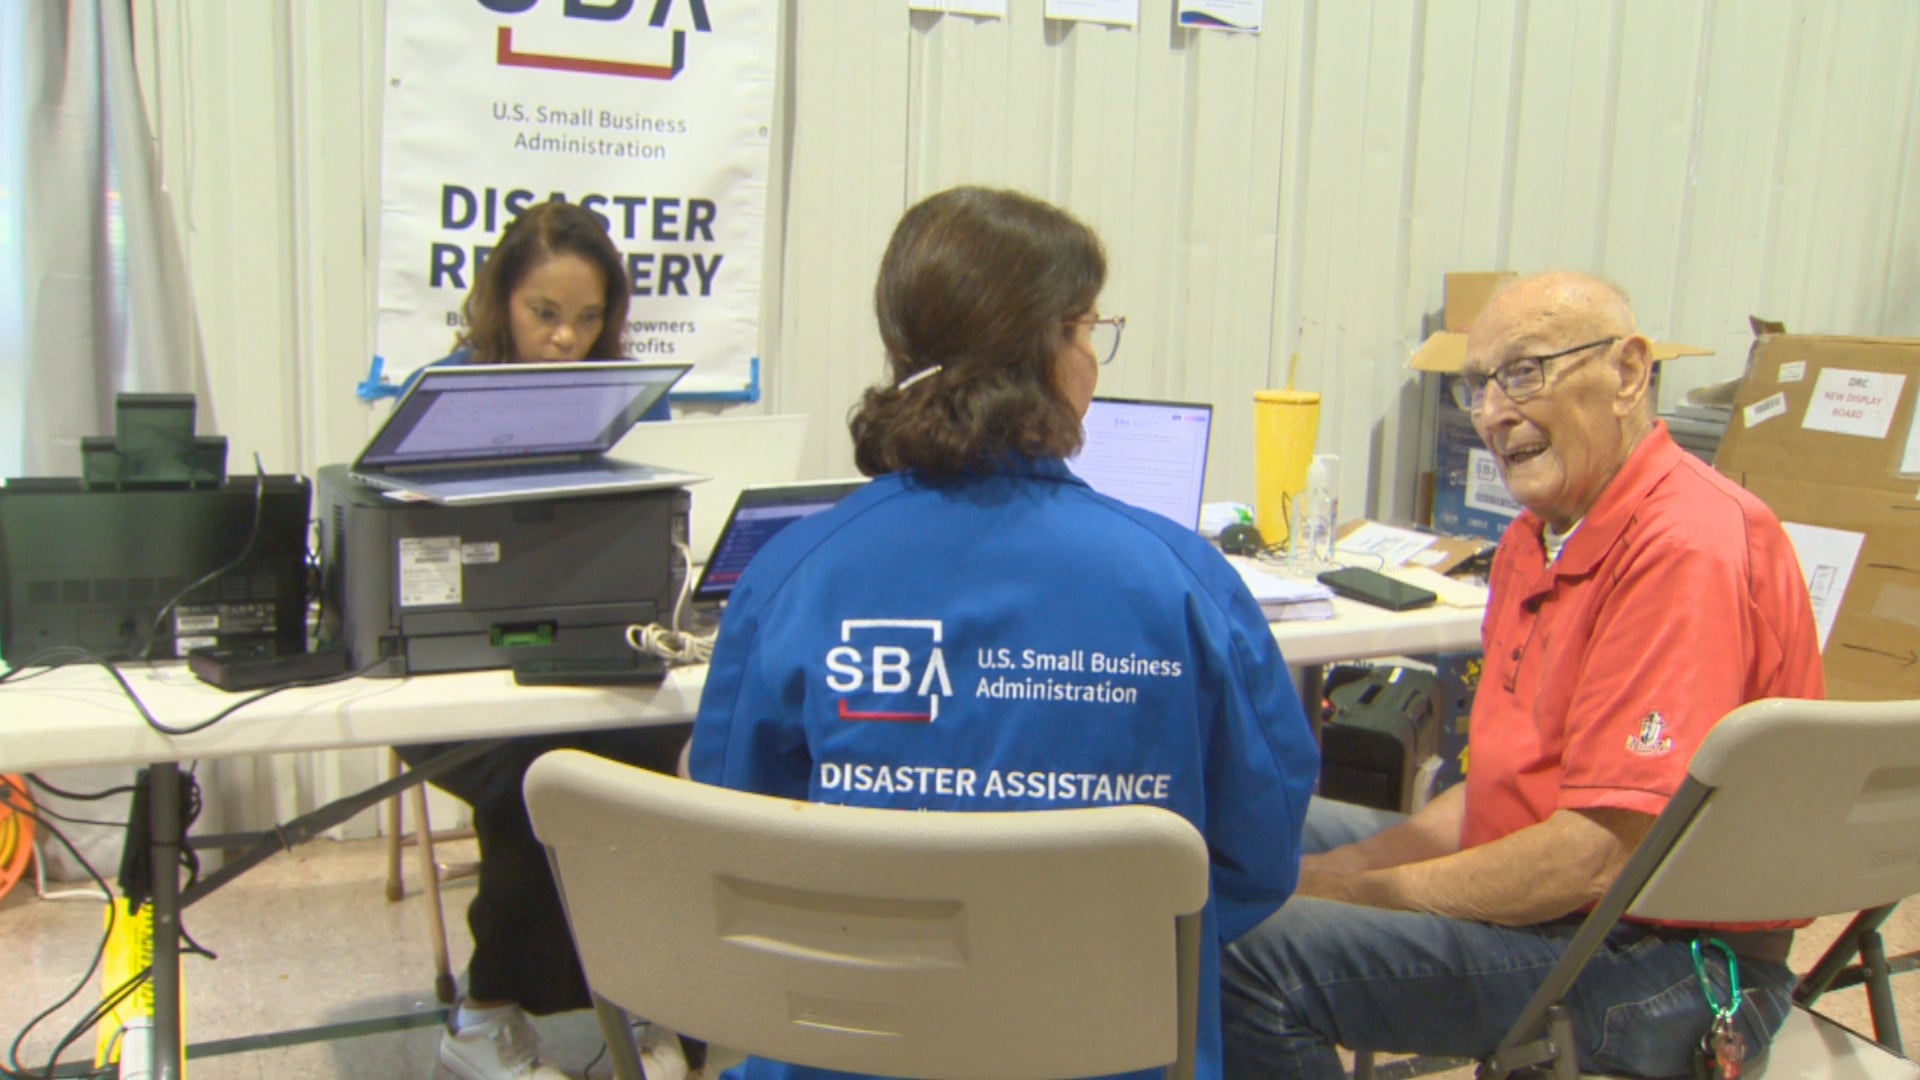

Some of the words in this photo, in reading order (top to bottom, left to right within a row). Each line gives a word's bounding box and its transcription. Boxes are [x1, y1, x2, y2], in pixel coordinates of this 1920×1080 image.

[492, 101, 530, 124] U.S.
[536, 105, 593, 128] Small
[600, 110, 687, 134] Business
[513, 132, 666, 159] Administration
[441, 184, 717, 242] DISSTER
[1848, 377, 1870, 388] DRC
[1823, 391, 1845, 401] NEW
[1846, 393, 1884, 406] DISPLAY
[1832, 407, 1863, 419] BOARD
[826, 645, 953, 697] SBA
[977, 648, 1015, 670] U.S.
[1022, 649, 1084, 672] Small
[1091, 652, 1182, 677] Business
[976, 677, 1137, 704] Administration
[820, 763, 976, 797] DISASTER
[984, 768, 1171, 802] ASSISTANCE
